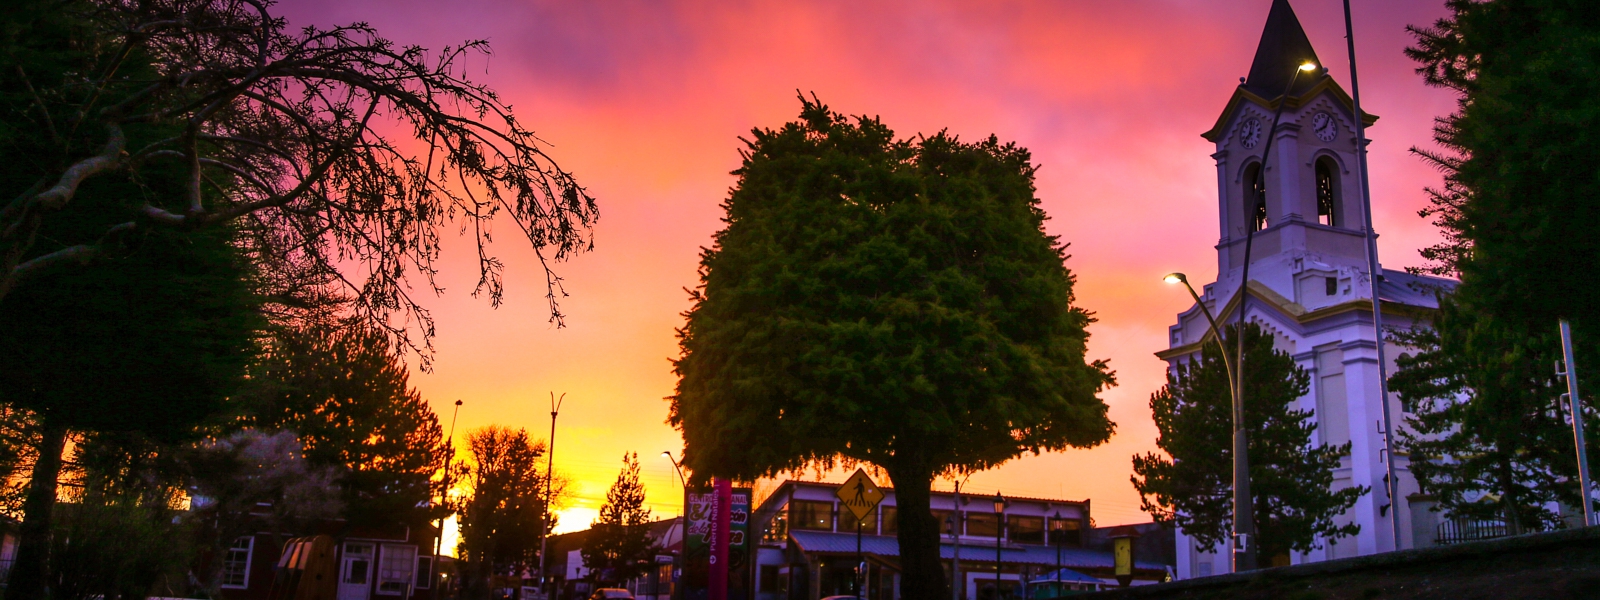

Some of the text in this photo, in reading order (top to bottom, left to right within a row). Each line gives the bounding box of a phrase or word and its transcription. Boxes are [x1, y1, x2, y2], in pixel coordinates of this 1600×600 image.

[690, 503, 710, 521] El
[711, 489, 719, 521] Natales
[710, 522, 718, 551] Puerto
